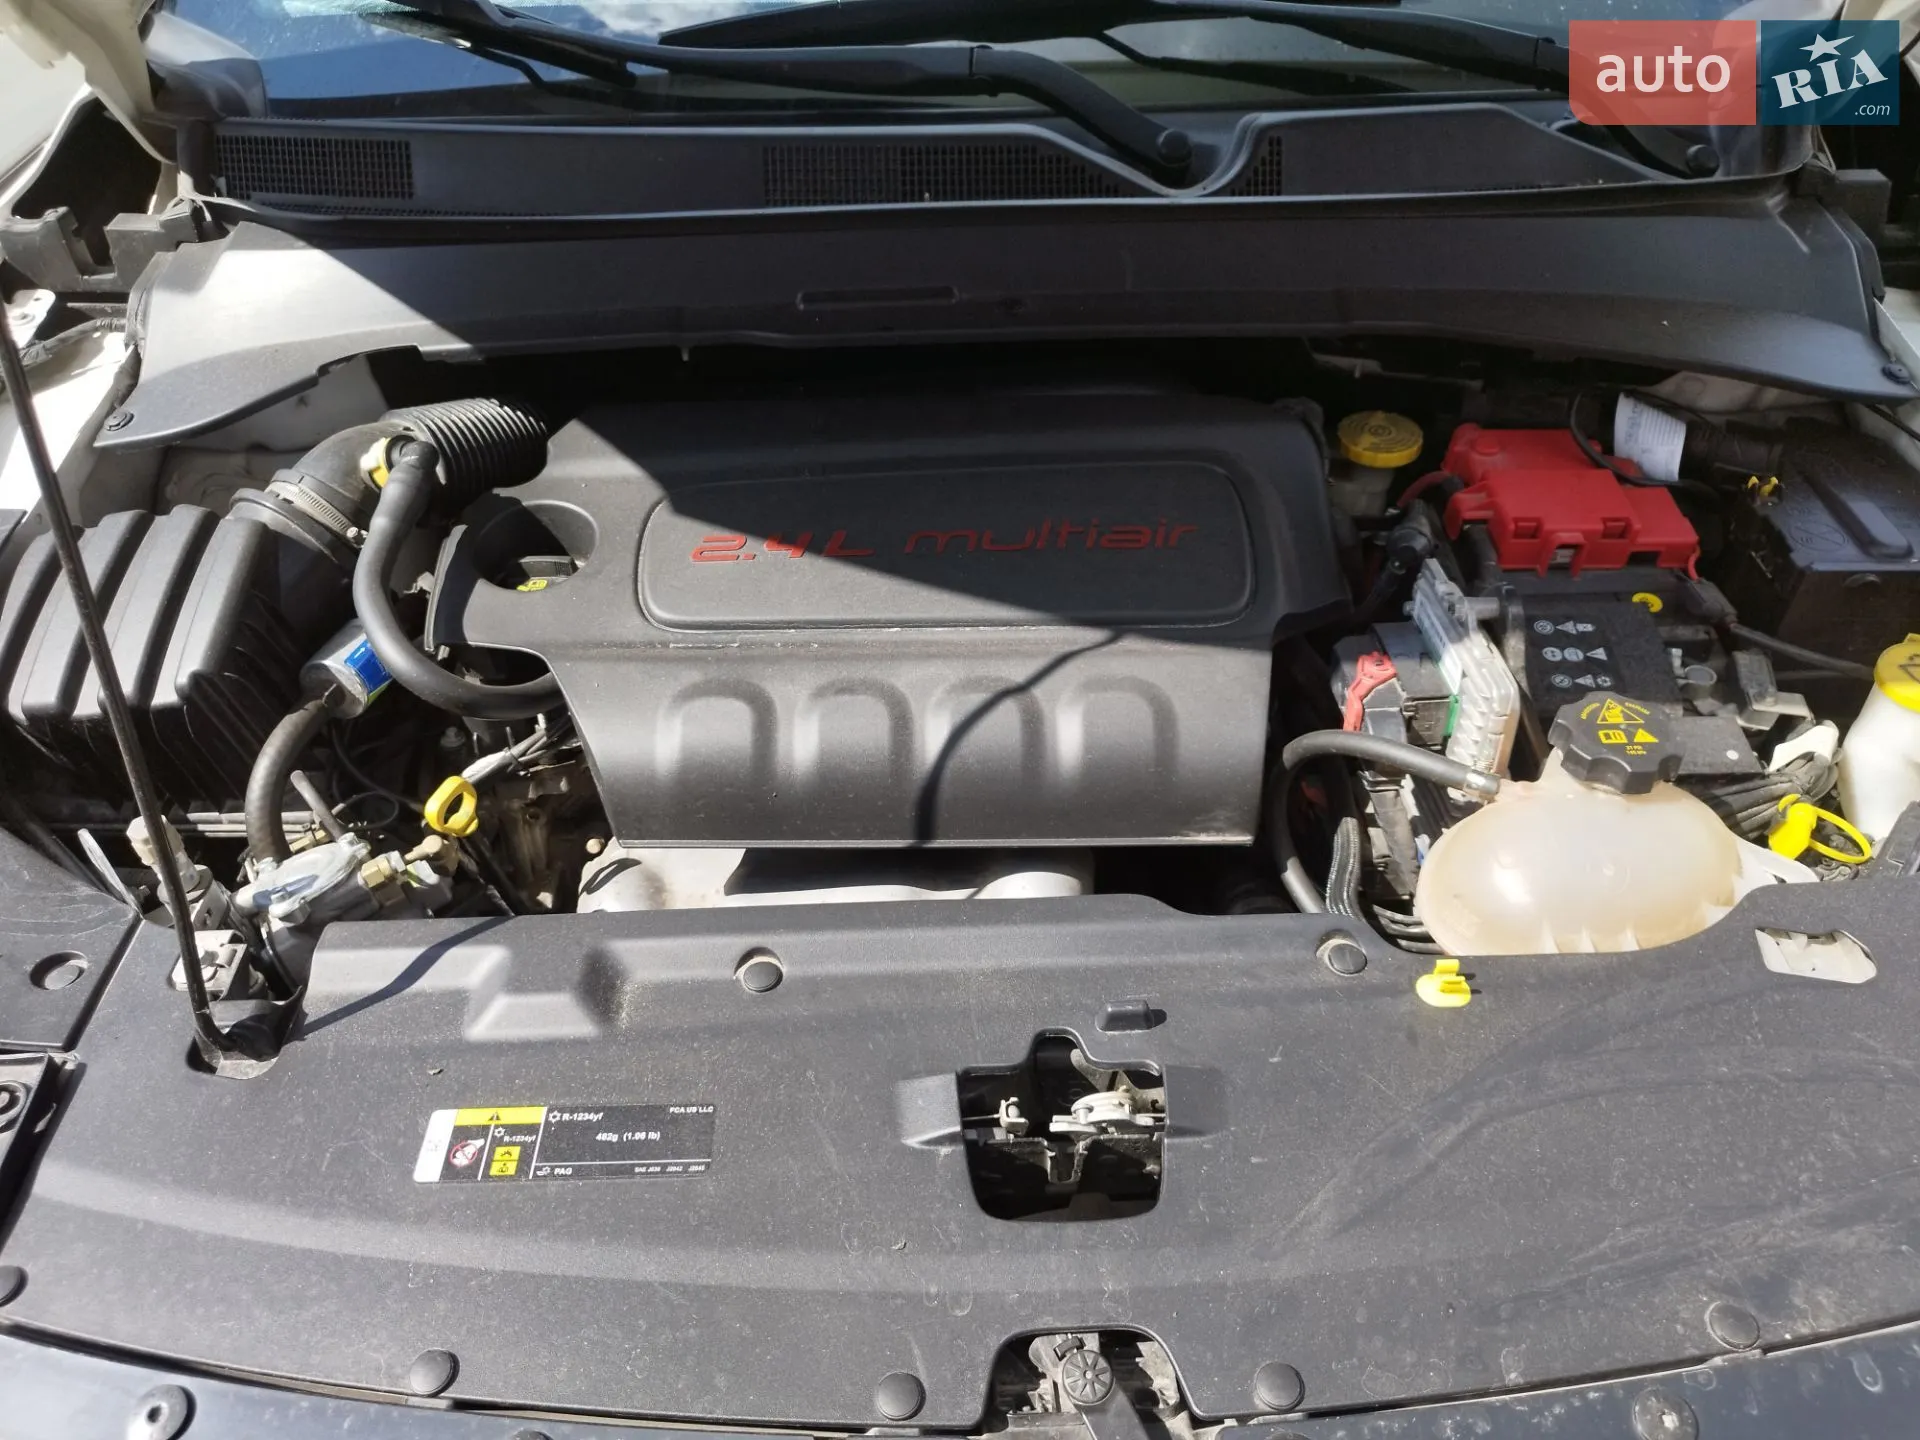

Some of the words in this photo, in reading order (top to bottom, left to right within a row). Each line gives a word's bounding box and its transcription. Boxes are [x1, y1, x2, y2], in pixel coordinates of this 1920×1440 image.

[903, 518, 1198, 554] multiair
[699, 1105, 713, 1113] LLC
[562, 1112, 603, 1122] R-1234yf
[648, 1131, 660, 1141] lb)
